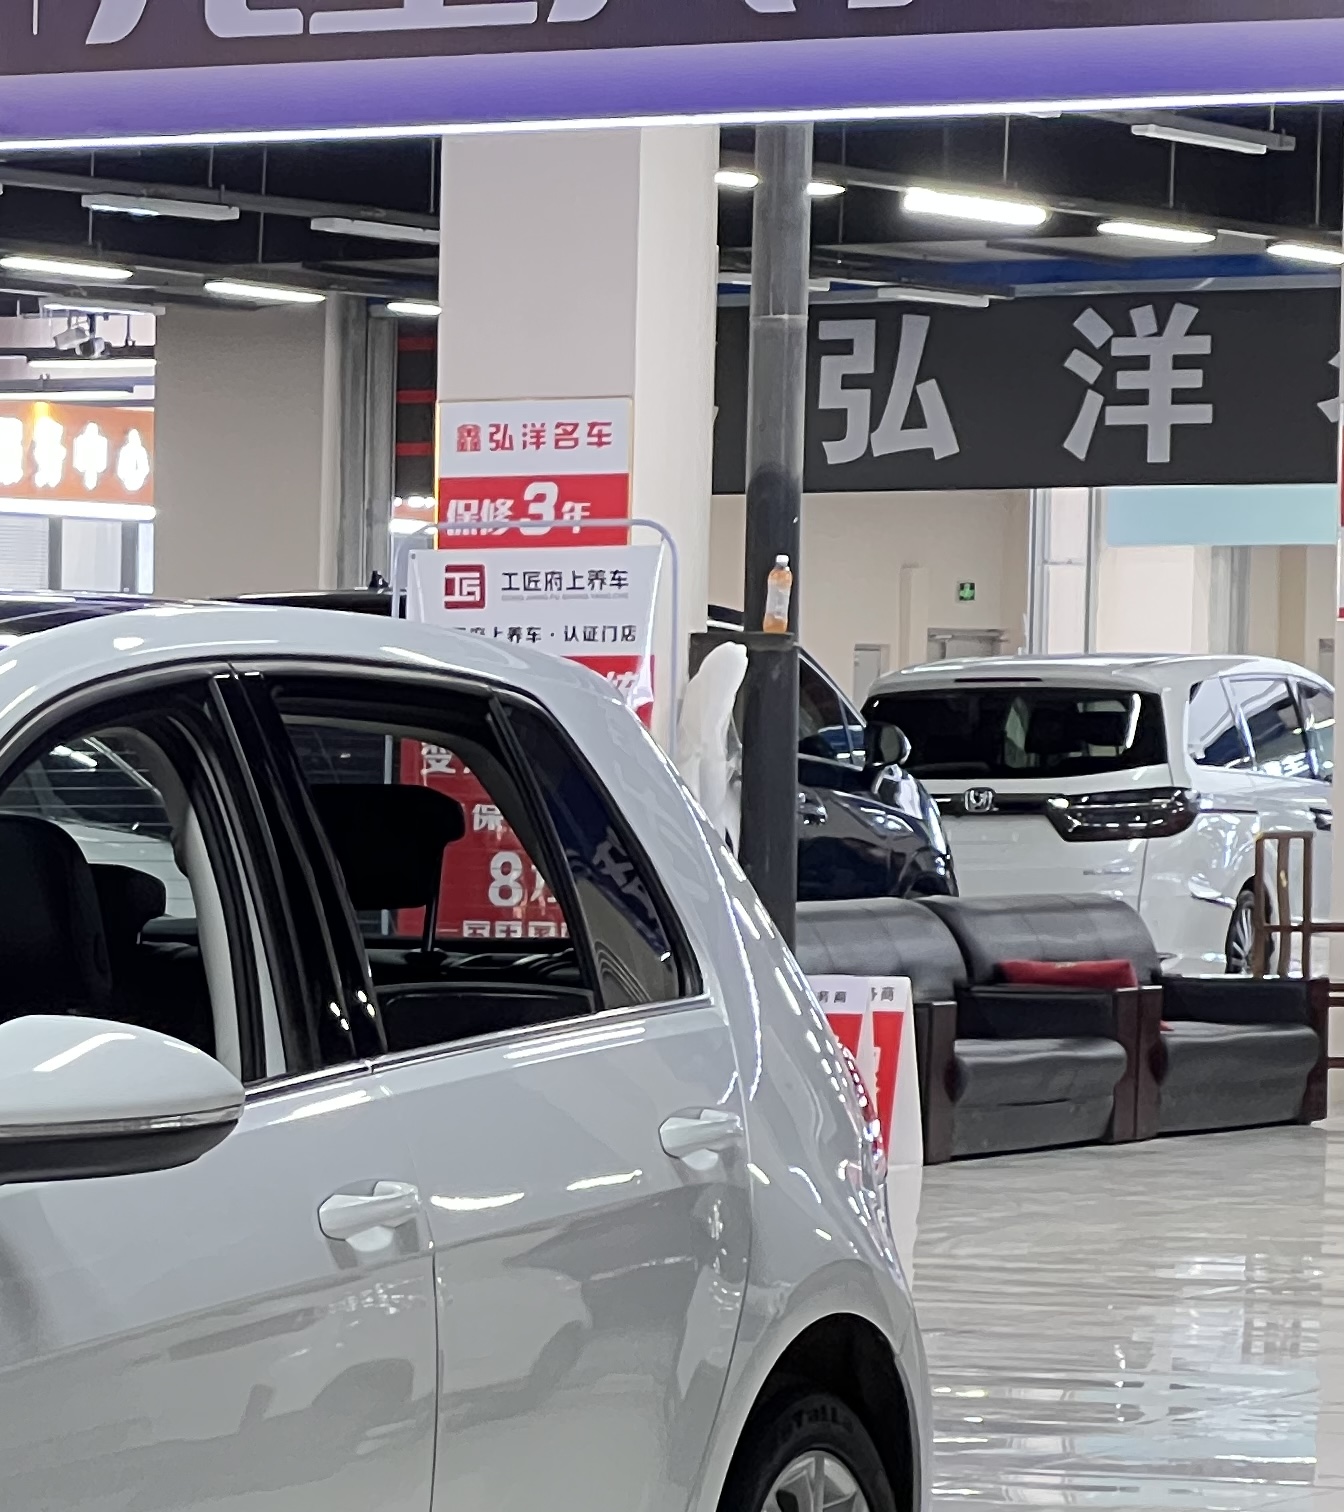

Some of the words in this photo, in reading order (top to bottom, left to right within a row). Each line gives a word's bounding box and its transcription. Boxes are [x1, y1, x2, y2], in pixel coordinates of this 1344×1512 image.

[818, 302, 1341, 465] 弘洋
[456, 421, 612, 453] 鑫弘洋名车
[446, 481, 591, 536] 保修3年
[501, 569, 629, 591] 工匠府上养车
